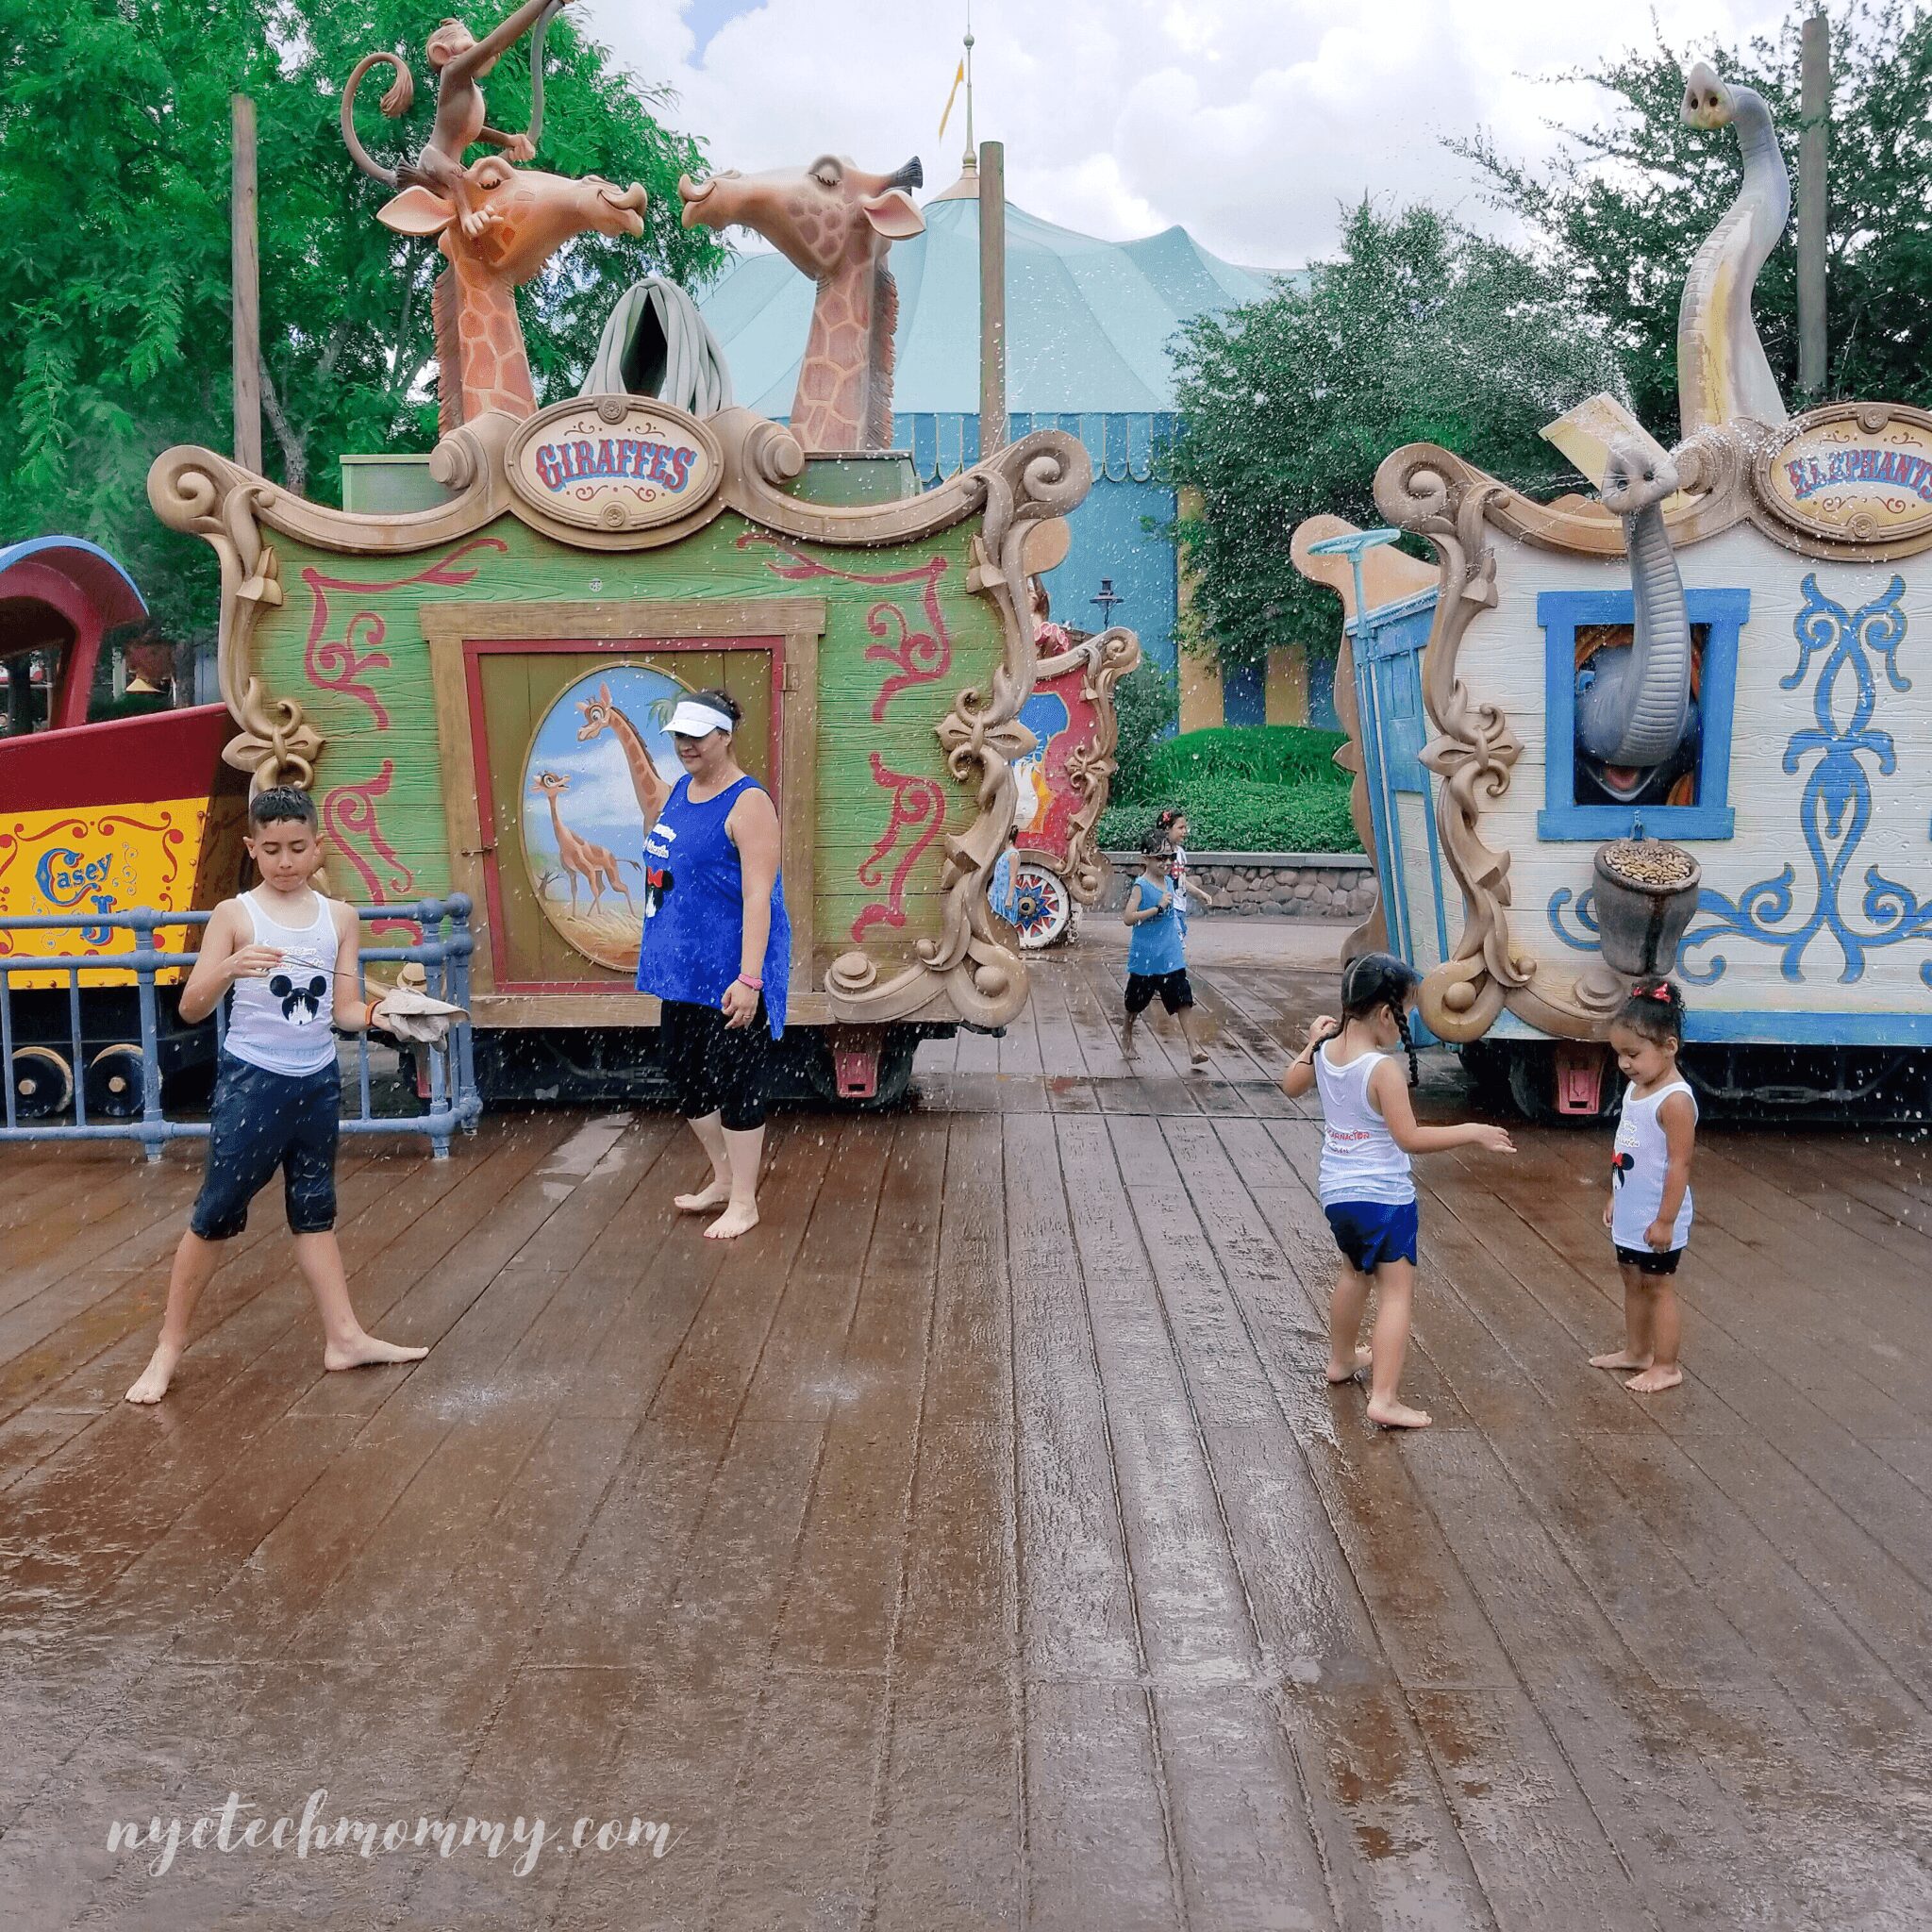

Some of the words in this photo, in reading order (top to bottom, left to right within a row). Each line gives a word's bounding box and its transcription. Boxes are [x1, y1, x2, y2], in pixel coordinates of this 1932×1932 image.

[535, 439, 698, 494] GIRAFFES
[34, 847, 113, 908] Casey
[79, 894, 130, 947] J
